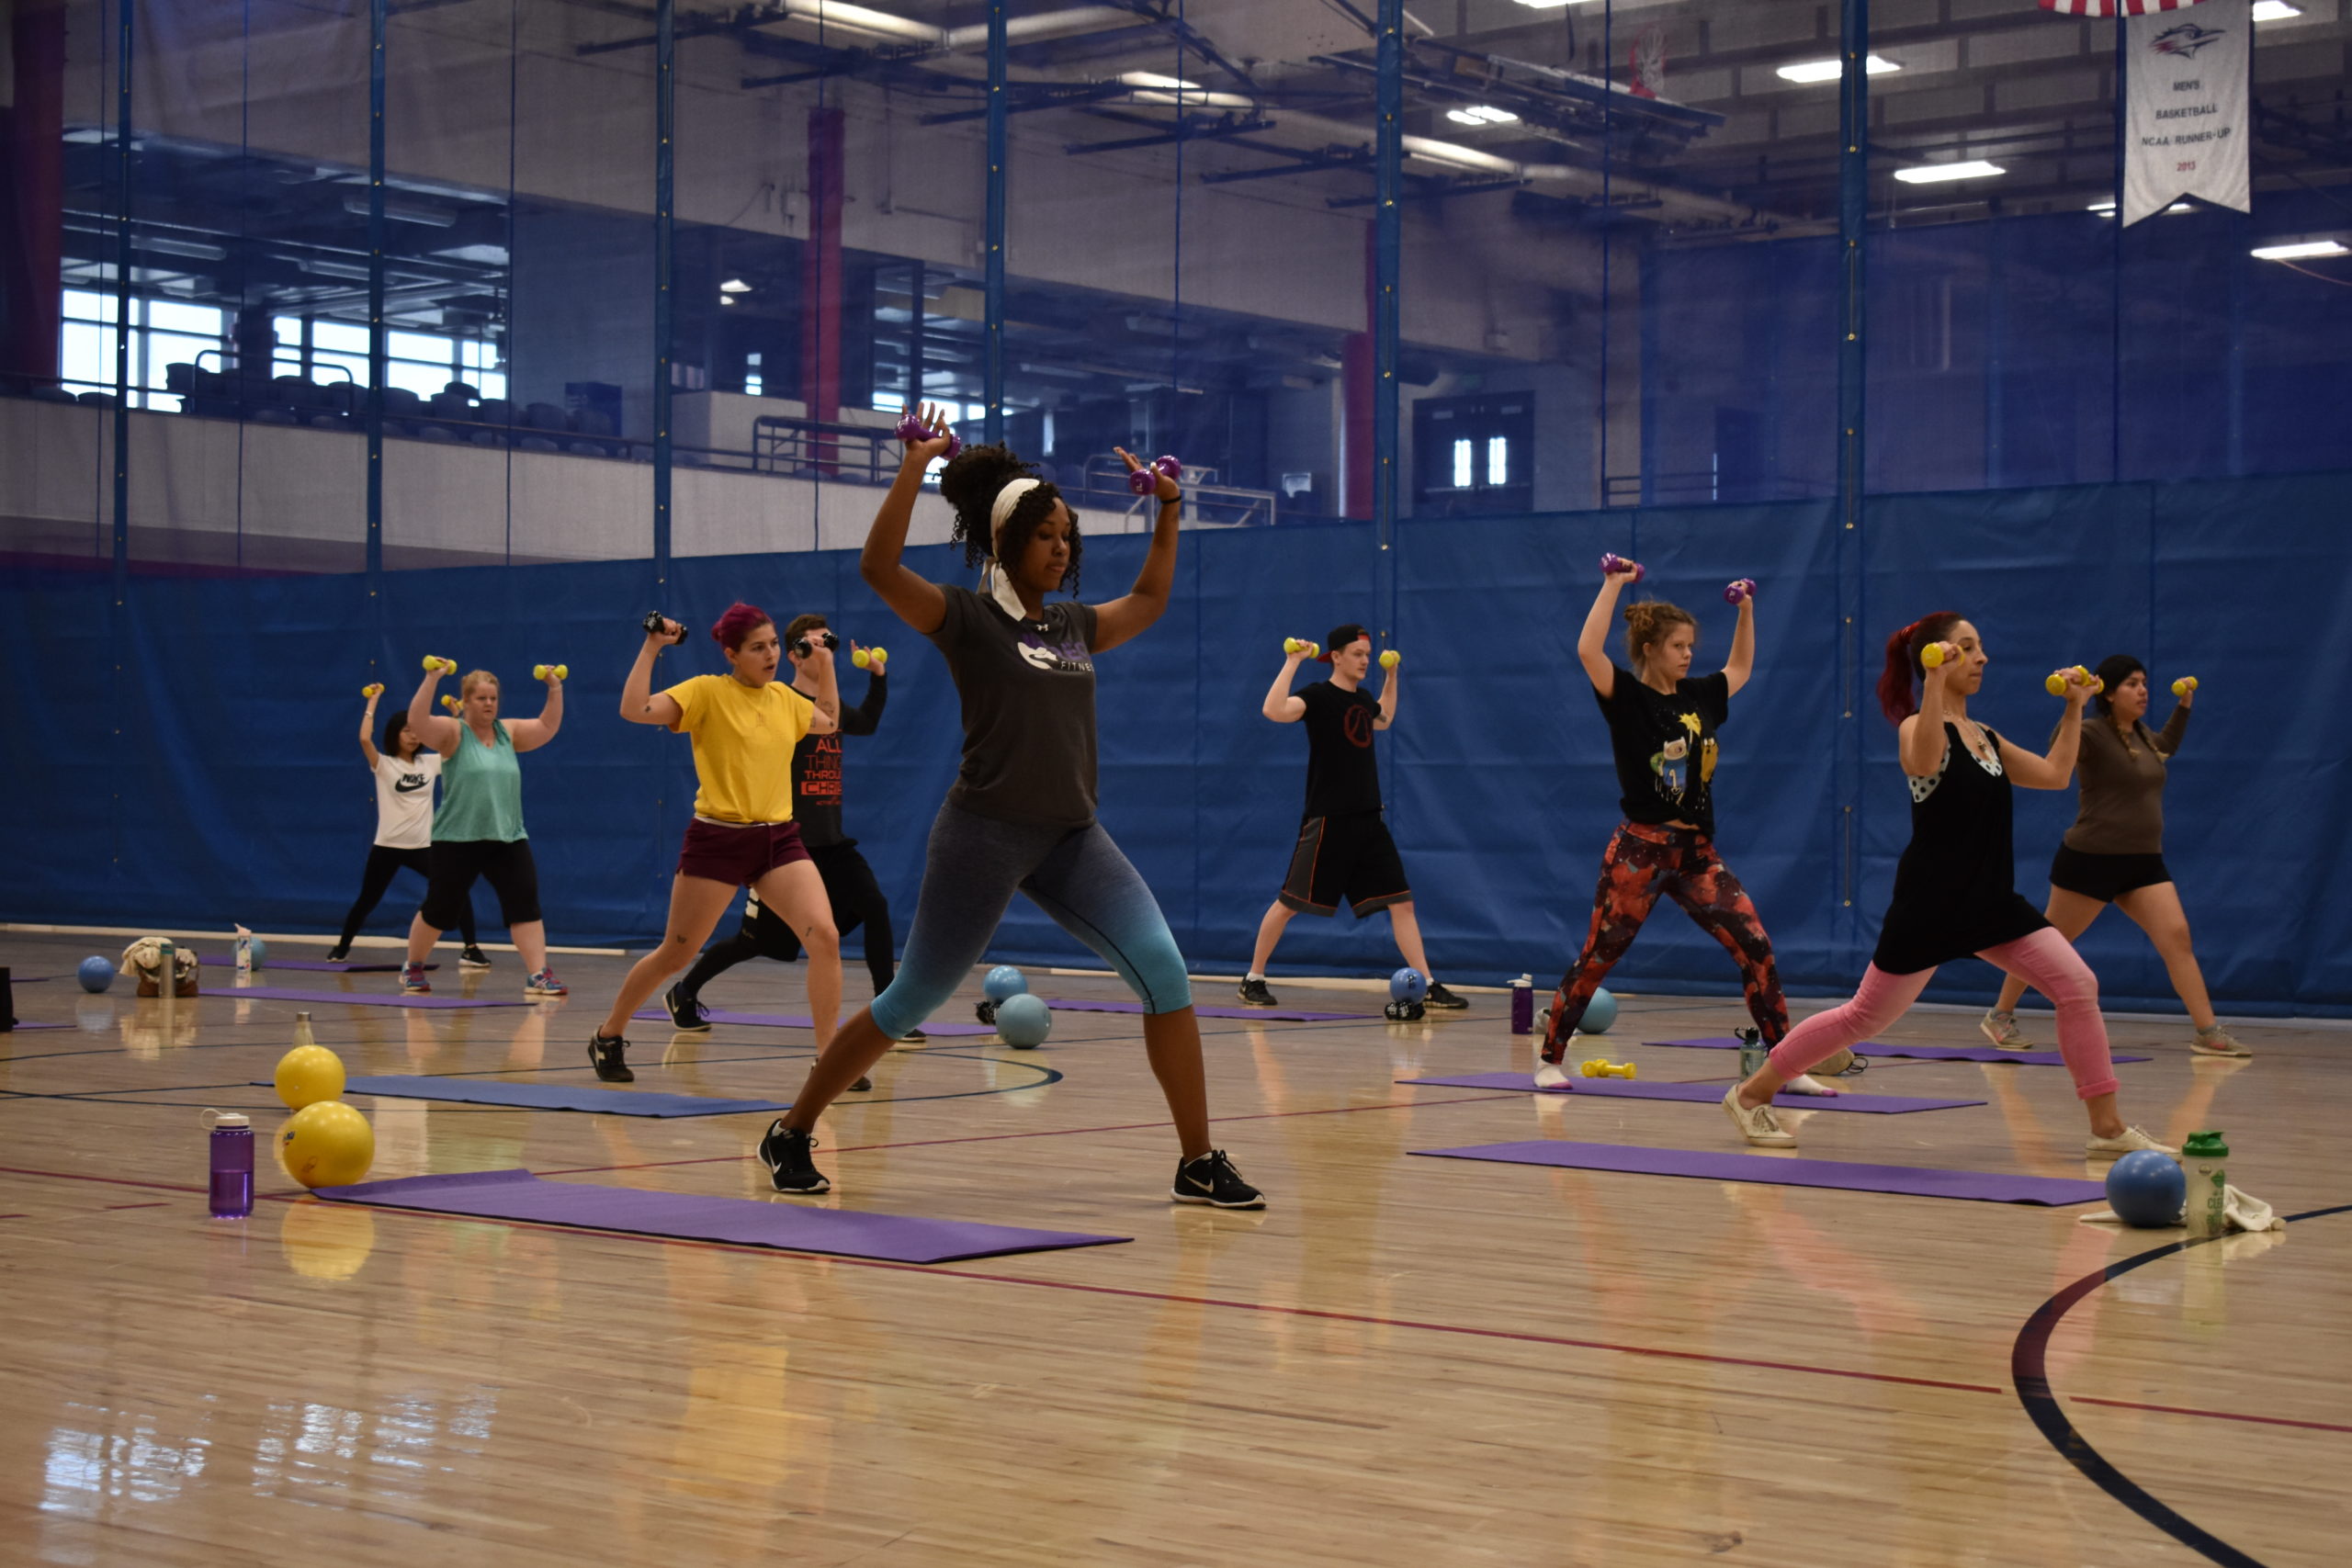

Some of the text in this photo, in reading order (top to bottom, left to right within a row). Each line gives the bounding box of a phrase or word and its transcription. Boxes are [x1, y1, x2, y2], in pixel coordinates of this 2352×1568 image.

[2173, 80, 2200, 92] MEN'S
[2155, 103, 2218, 119] BASKETBALL
[2142, 127, 2231, 146] NCAA RUNNER-UP
[816, 739, 842, 753] ALL
[402, 773, 425, 784] NIKE
